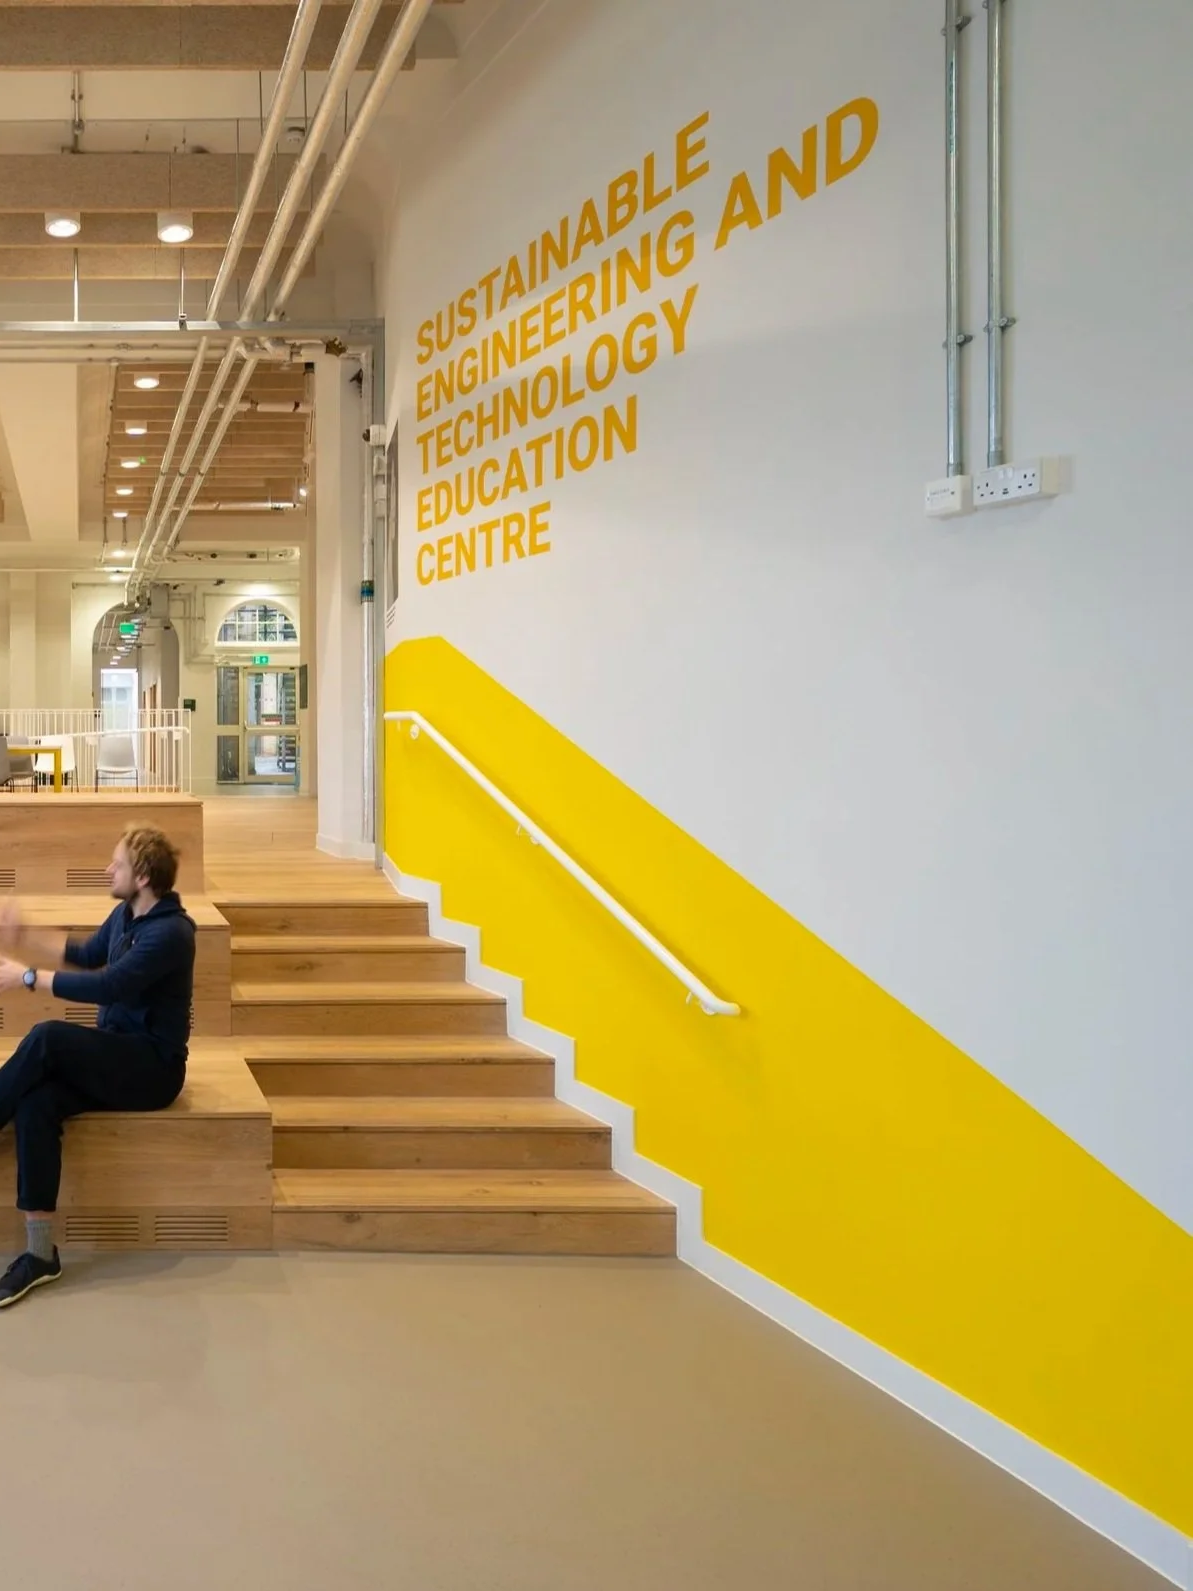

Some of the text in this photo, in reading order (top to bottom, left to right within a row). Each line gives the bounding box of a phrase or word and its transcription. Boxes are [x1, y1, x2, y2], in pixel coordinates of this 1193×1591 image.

[416, 111, 710, 365] SUSTAINABLE
[416, 97, 879, 421] ENGINEERING AND
[416, 285, 698, 474] TECHNOLOGY
[416, 395, 638, 532] EDUCATION
[416, 502, 551, 586] CENTRE
